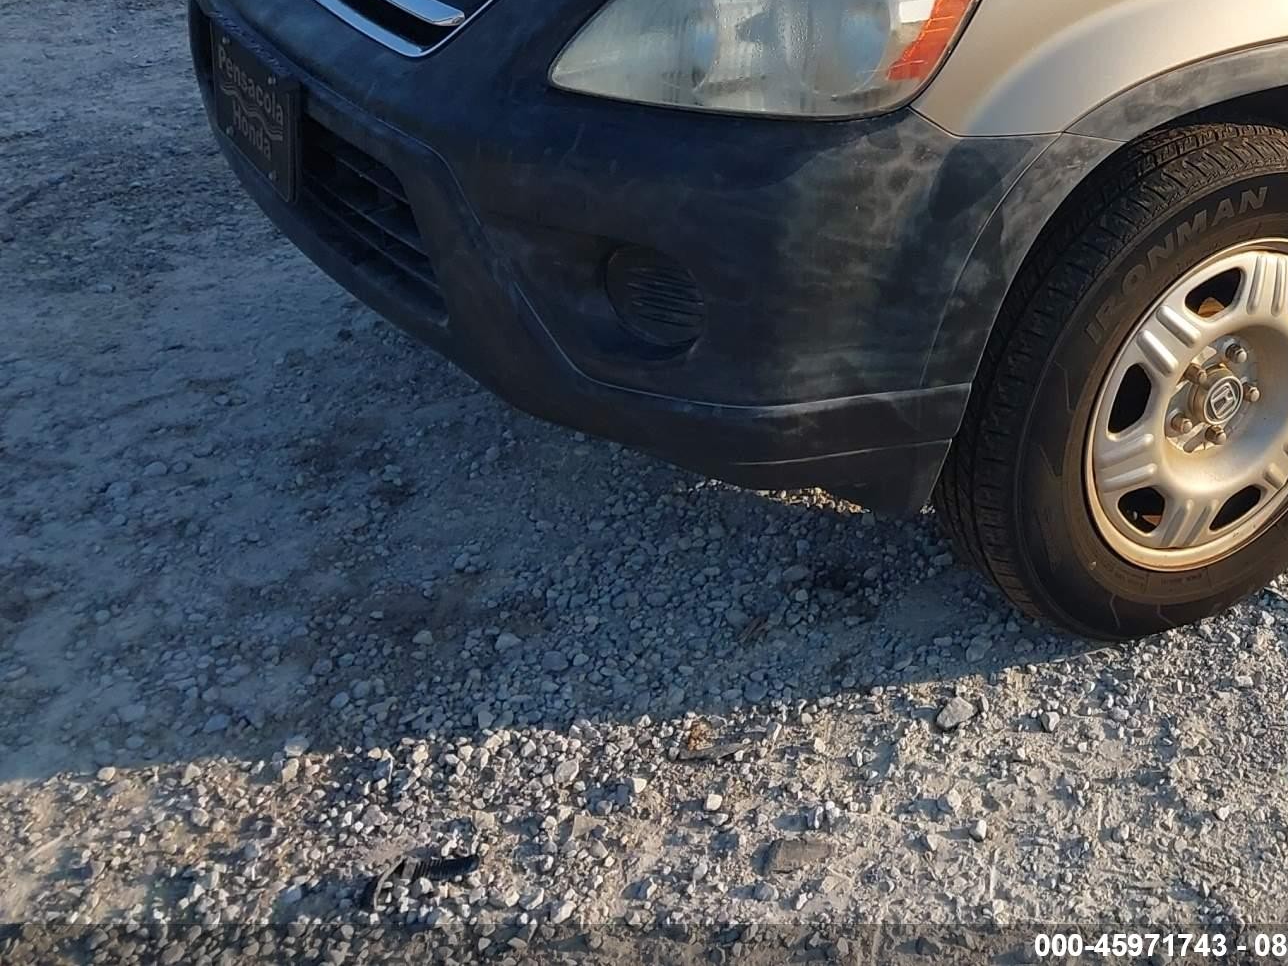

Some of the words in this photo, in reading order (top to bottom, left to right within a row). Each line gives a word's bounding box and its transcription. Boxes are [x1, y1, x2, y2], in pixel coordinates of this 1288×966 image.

[217, 45, 284, 127] Pensacola
[232, 99, 272, 160] Honda
[1085, 186, 1268, 345] IRONMAN
